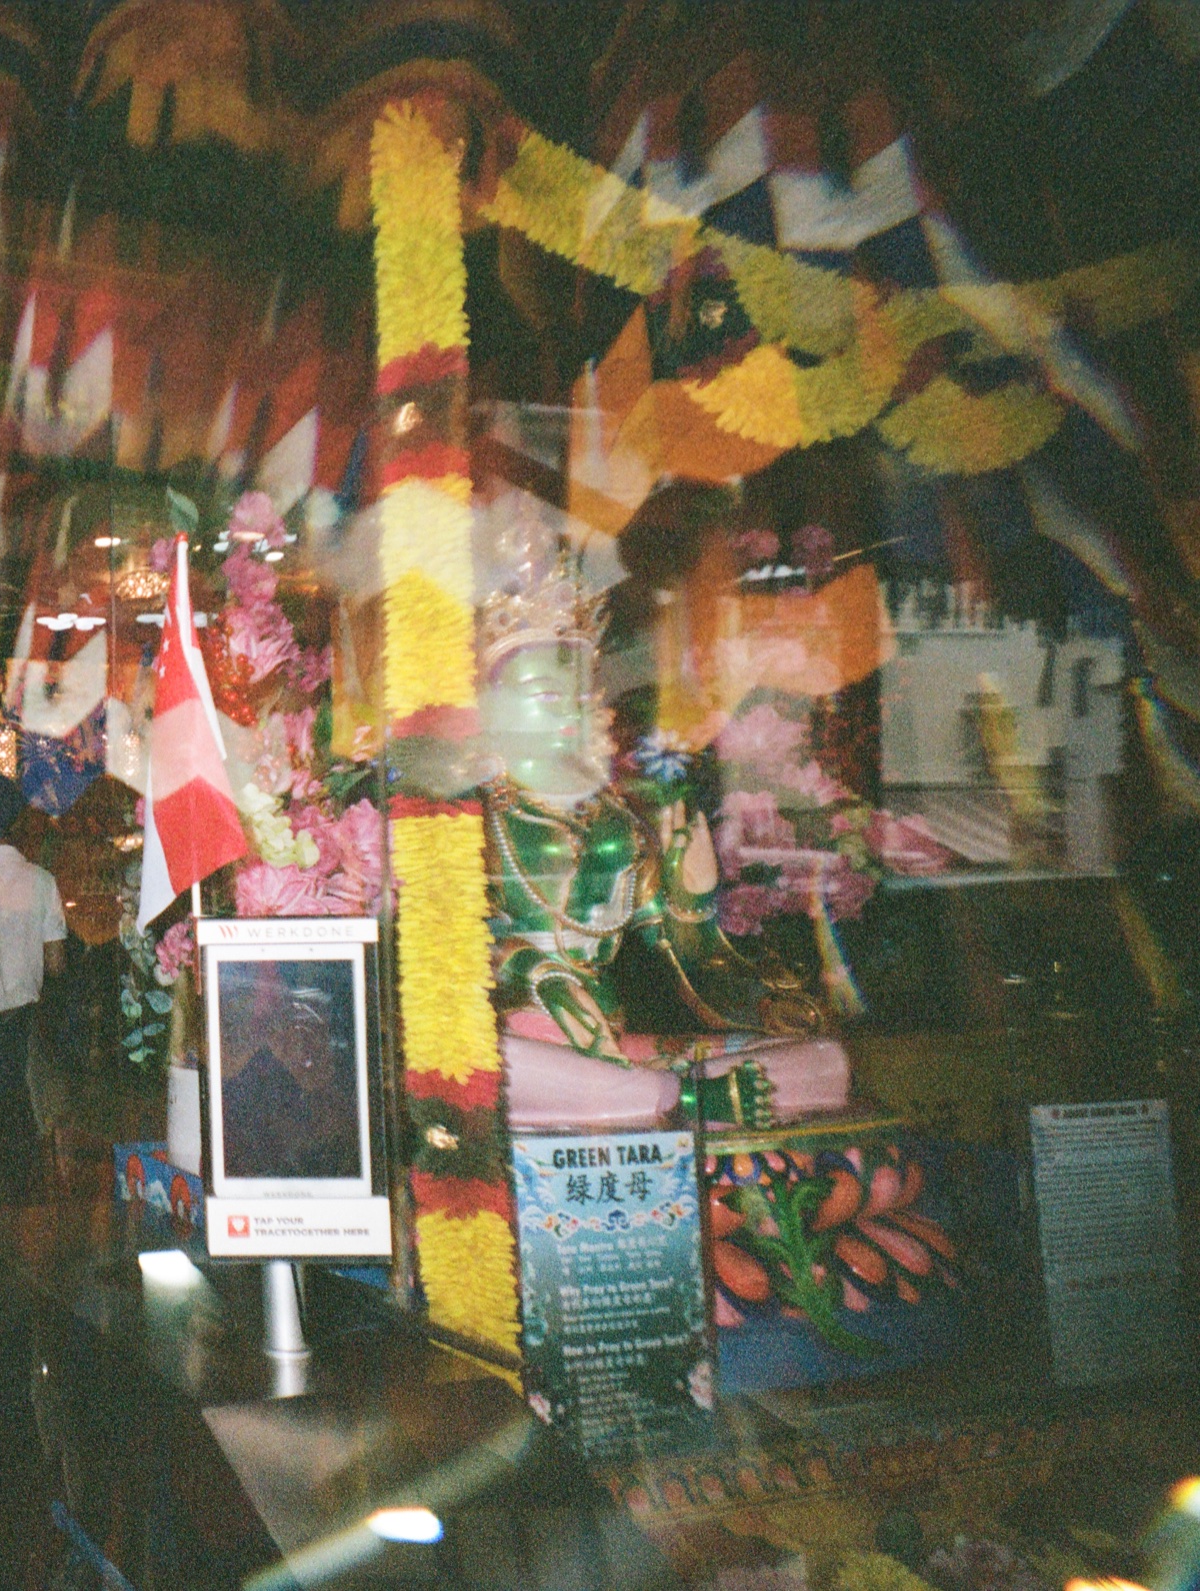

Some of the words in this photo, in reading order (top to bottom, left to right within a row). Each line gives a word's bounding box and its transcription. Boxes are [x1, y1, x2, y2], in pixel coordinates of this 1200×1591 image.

[247, 925, 354, 938] WERKDONE
[553, 1147, 611, 1169] GREEN
[616, 1143, 662, 1165] TARA
[566, 1170, 654, 1205] 绿度母
[254, 1217, 273, 1225] TAP
[276, 1217, 304, 1225] YOUR
[254, 1228, 340, 1236] TRACETOGETHER
[343, 1228, 370, 1236] HERE
